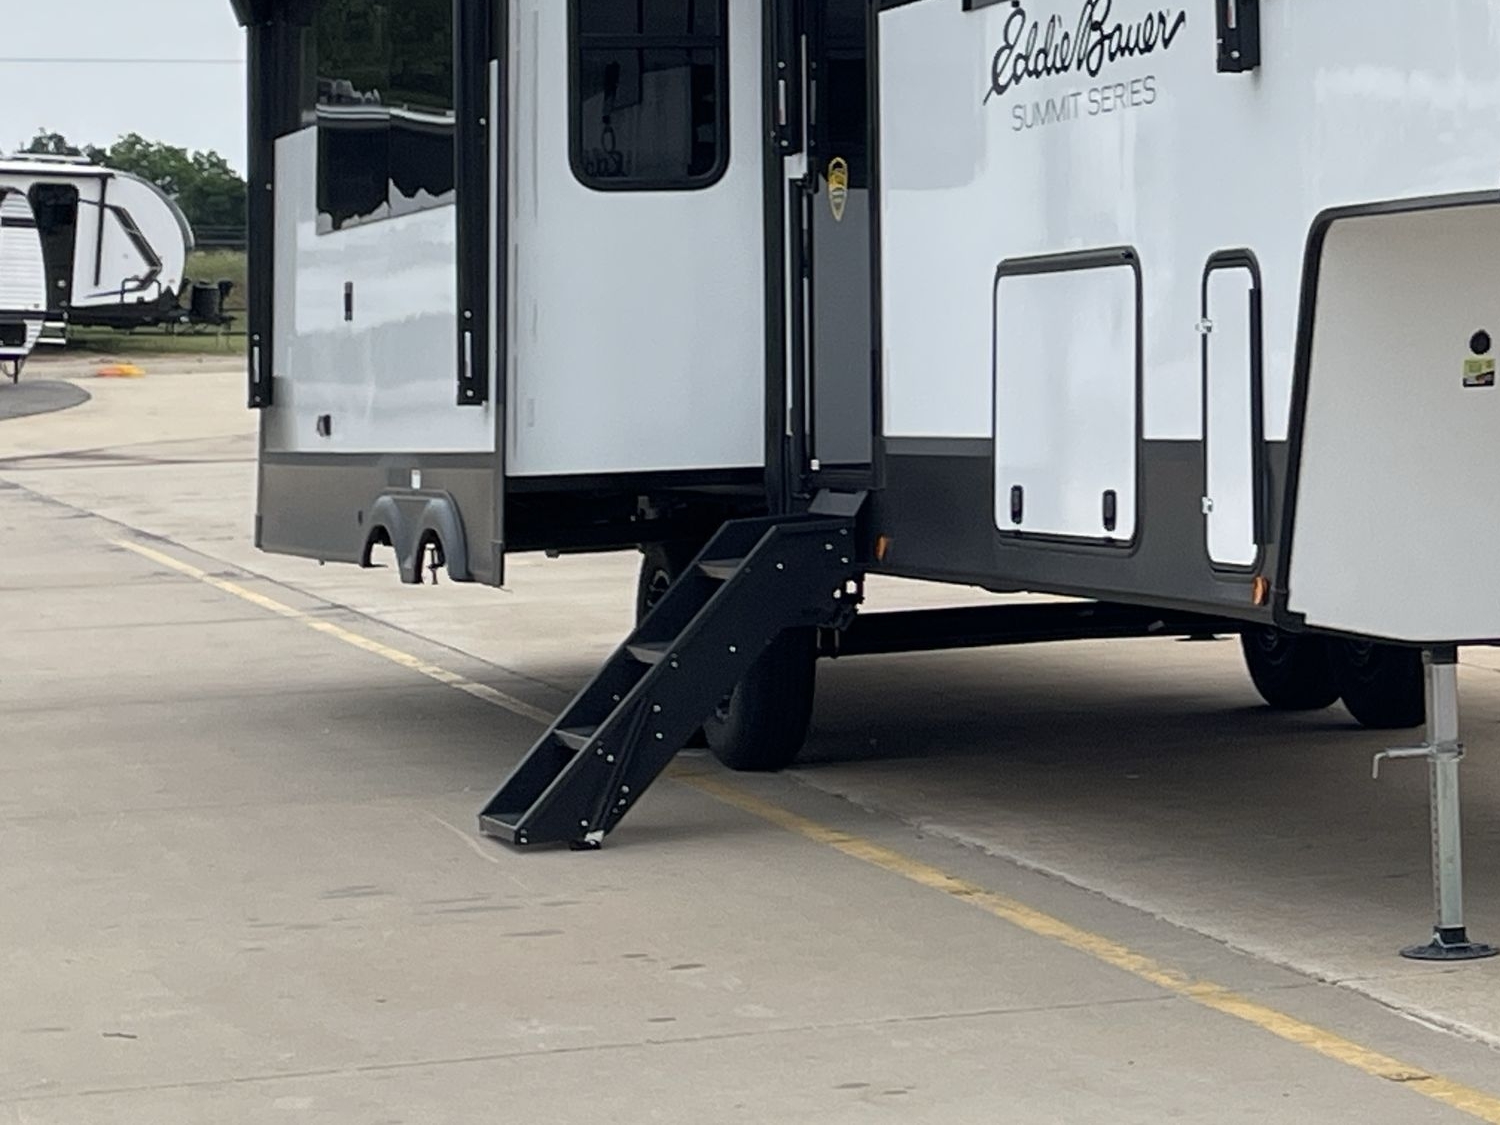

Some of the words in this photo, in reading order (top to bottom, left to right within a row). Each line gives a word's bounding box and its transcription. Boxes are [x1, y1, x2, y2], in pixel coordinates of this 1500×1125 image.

[983, 6, 1073, 106] Eddie
[1012, 92, 1082, 132] SUMMIT
[1087, 75, 1157, 116] SERIES
